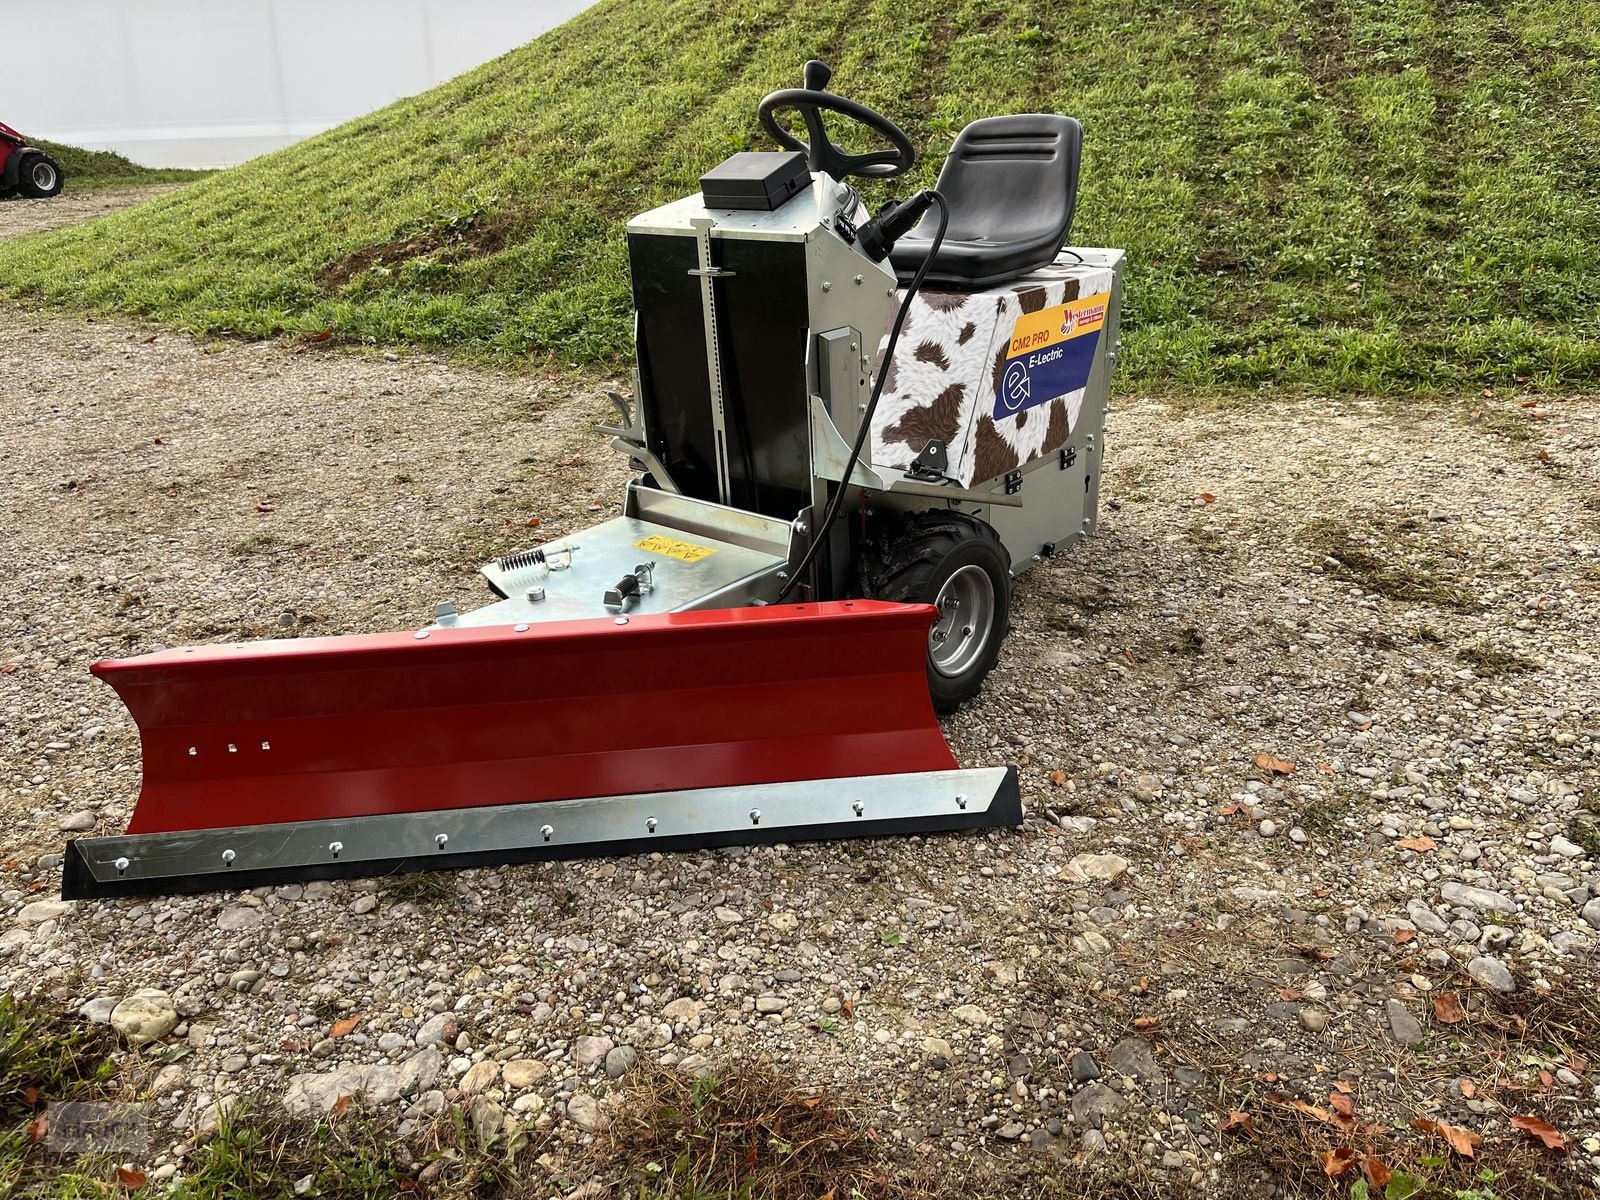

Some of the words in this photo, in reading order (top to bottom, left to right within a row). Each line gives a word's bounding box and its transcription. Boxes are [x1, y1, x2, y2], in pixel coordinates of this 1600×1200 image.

[1012, 338, 1031, 352] CM2
[1032, 329, 1050, 347] PRO
[1028, 347, 1064, 369] E-Lectric
